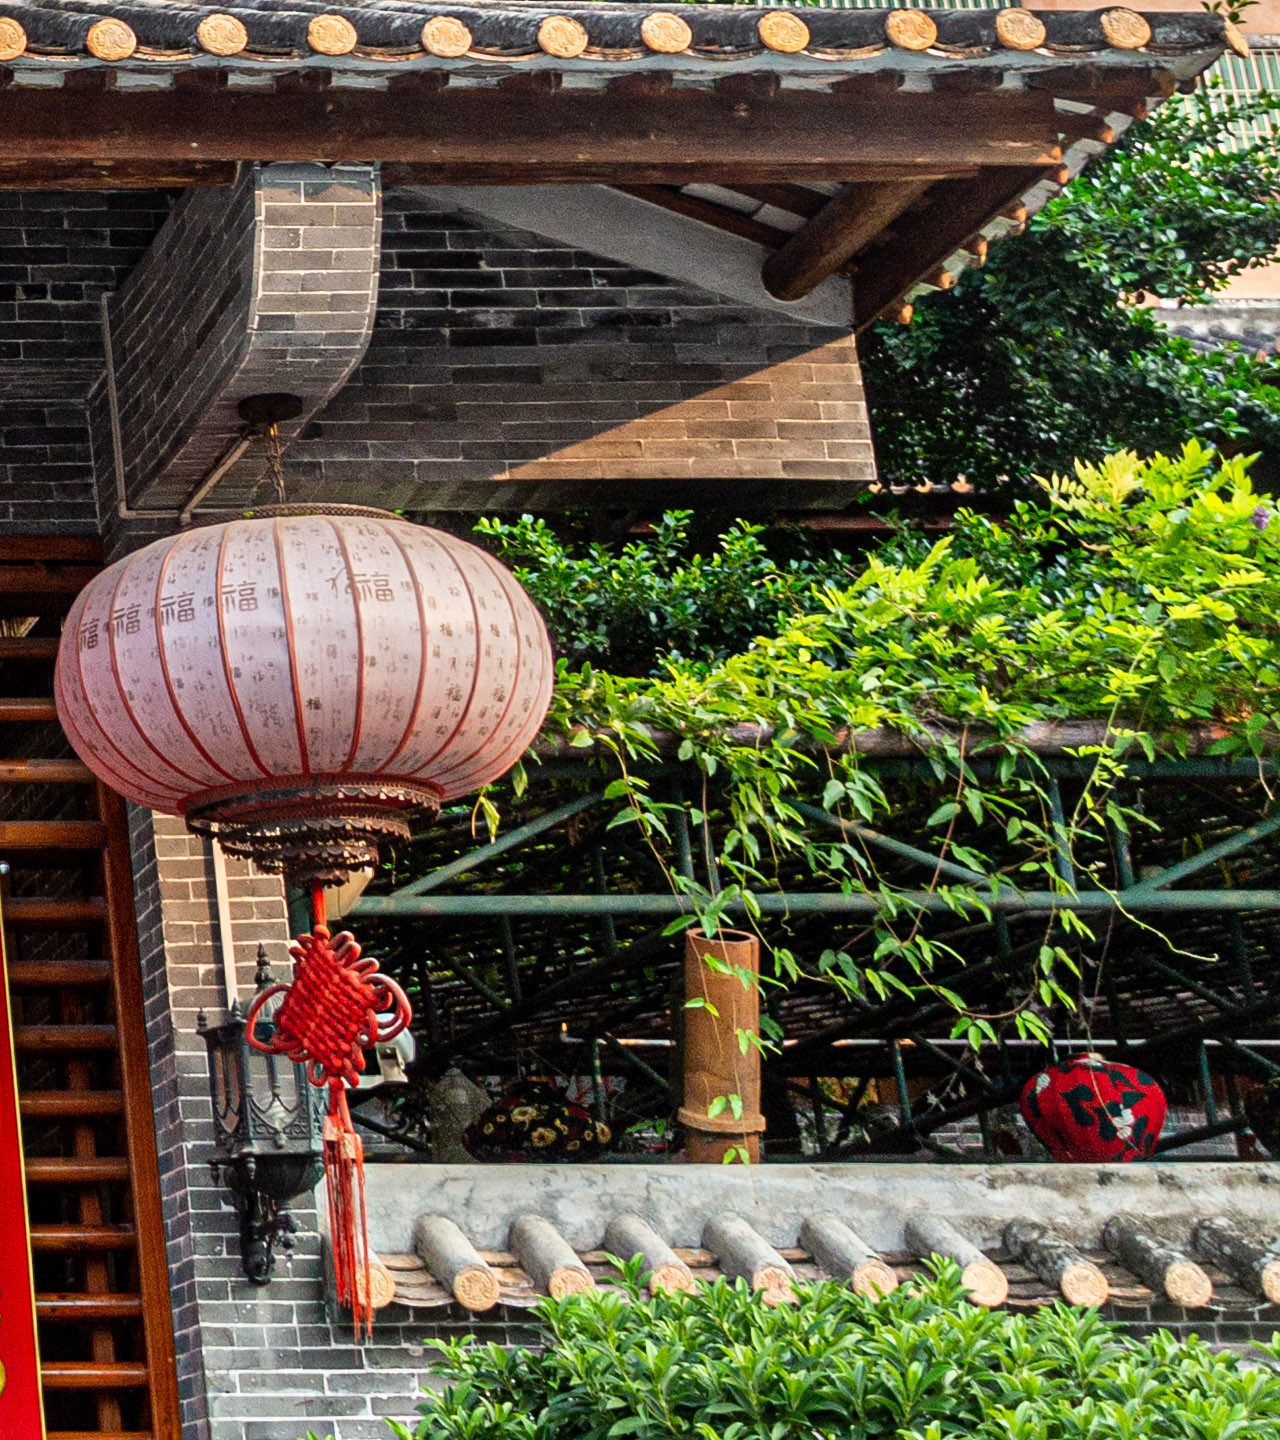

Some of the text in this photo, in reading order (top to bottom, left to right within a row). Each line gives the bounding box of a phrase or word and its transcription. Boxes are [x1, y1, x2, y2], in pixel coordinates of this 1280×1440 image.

[221, 580, 258, 613] 福
[356, 572, 394, 602] 福
[114, 603, 141, 638] 福
[161, 591, 195, 626] 福
[79, 618, 99, 652] 福
